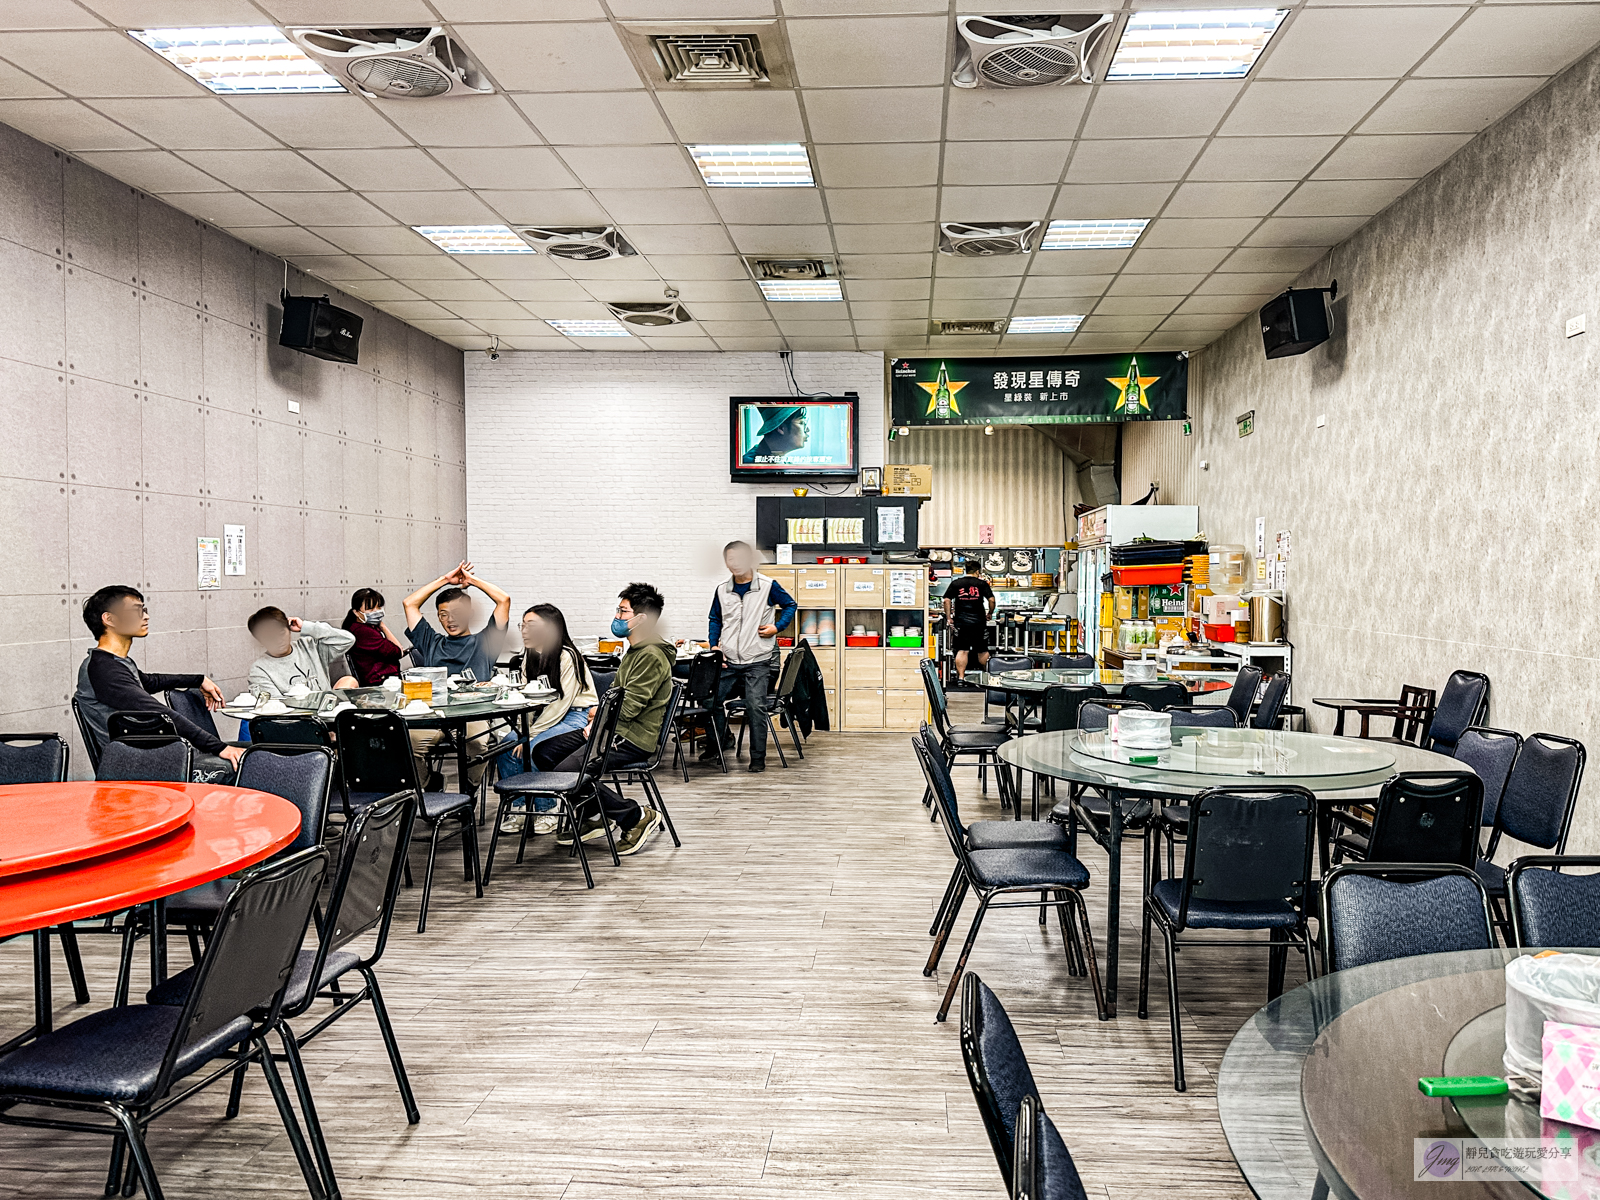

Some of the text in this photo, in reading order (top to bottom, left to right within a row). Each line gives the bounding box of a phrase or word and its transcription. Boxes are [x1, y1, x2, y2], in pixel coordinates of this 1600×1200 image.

[993, 370, 1081, 390] 發現星傳奇
[1004, 392, 1069, 403] 星綠裝 新上市
